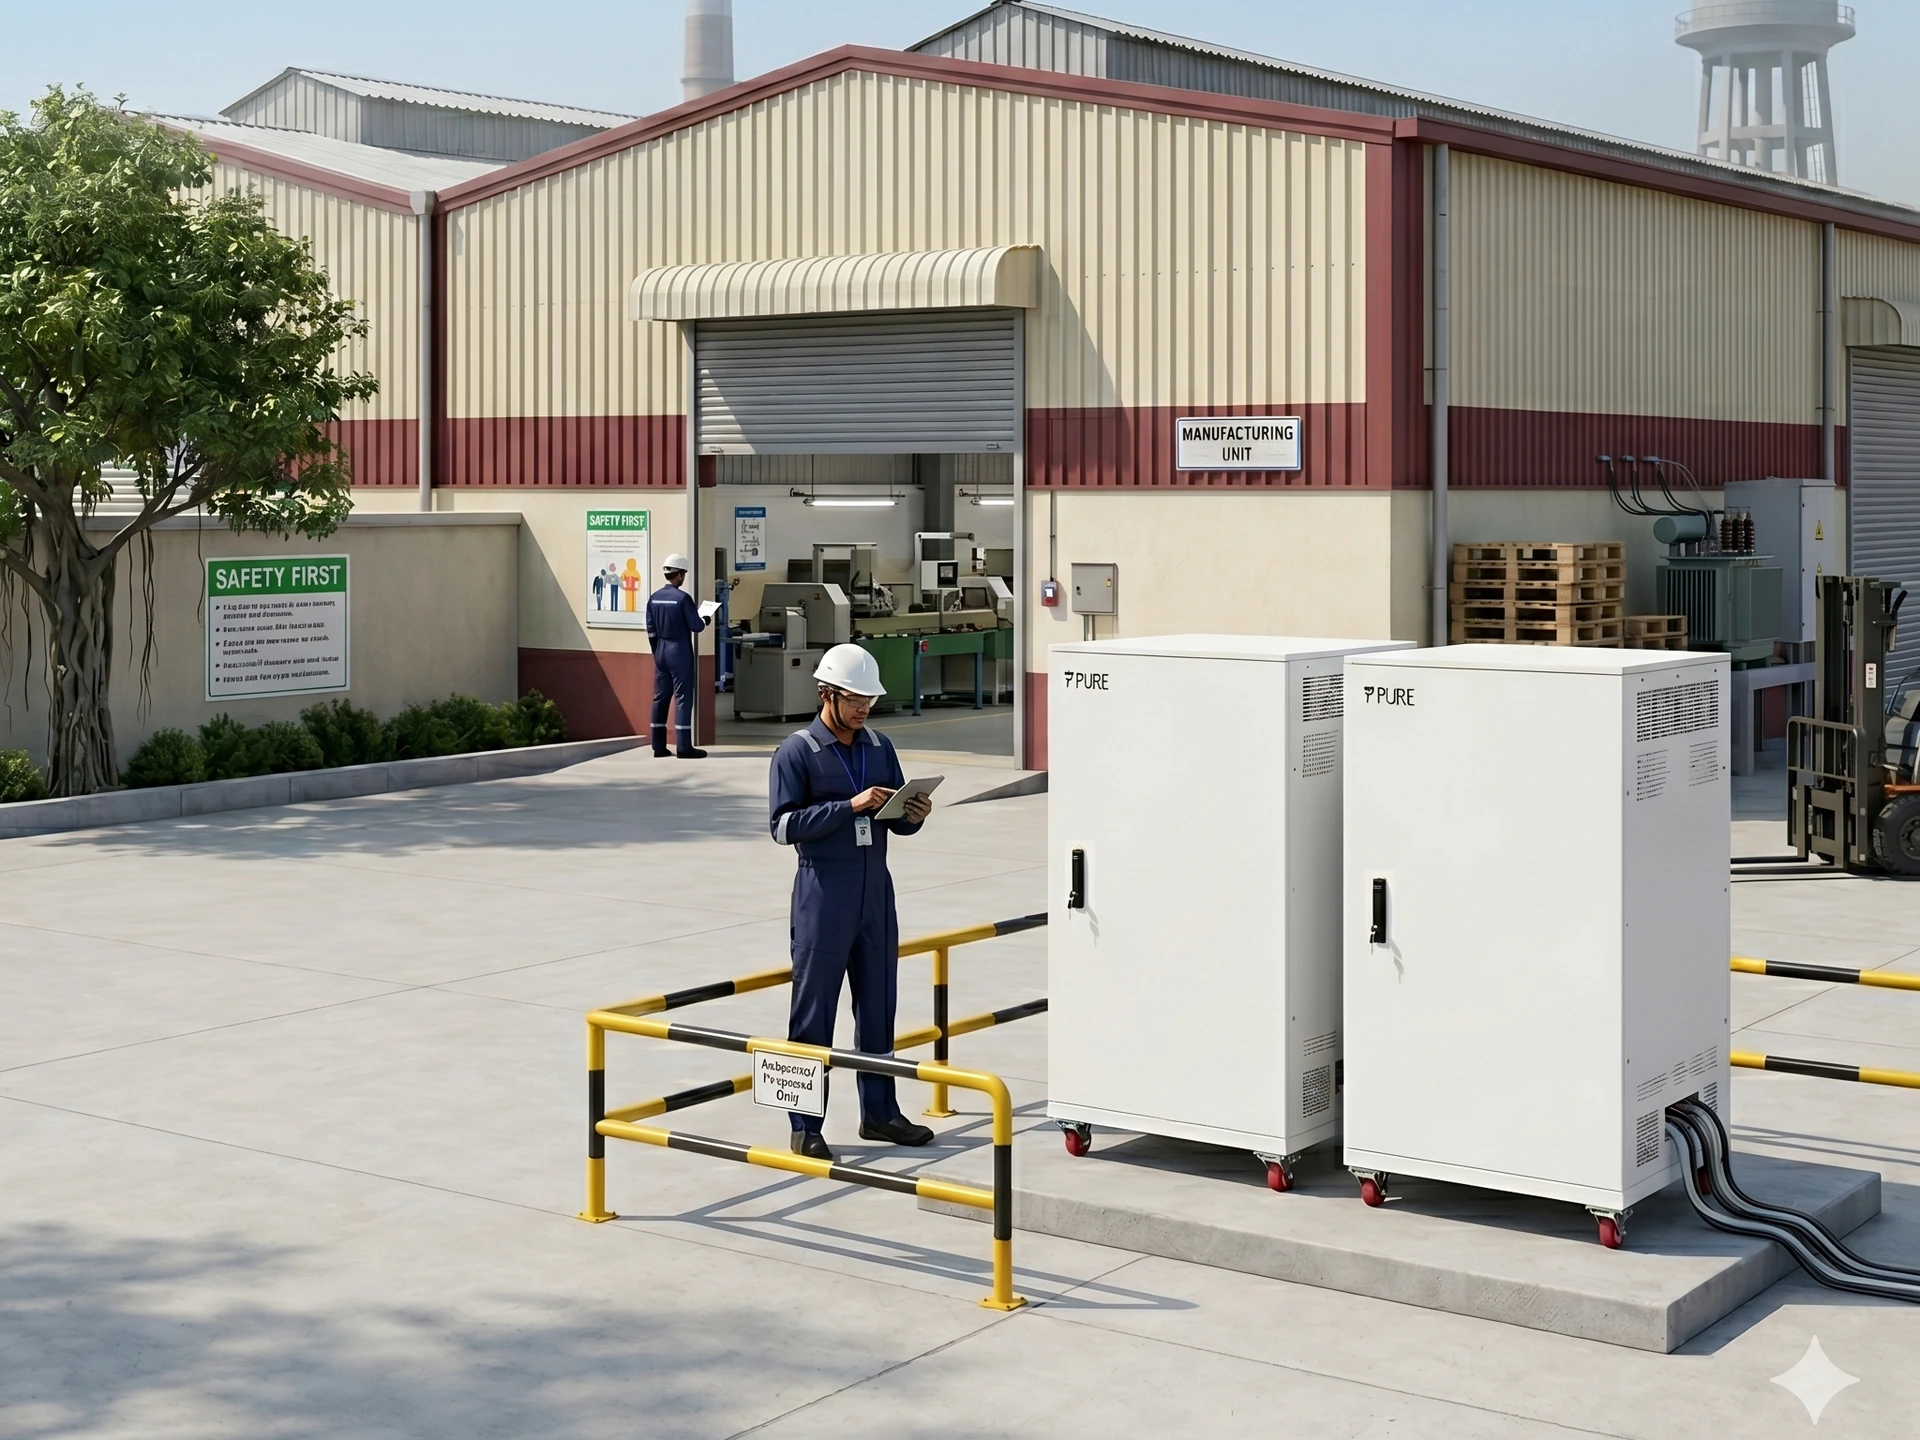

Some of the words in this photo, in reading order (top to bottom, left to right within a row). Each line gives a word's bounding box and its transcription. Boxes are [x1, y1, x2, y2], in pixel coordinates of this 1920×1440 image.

[1182, 425, 1294, 441] MANUFACTURING
[1222, 446, 1252, 462] UNIT
[589, 514, 620, 527] SAFETY
[621, 514, 645, 527] FIRST
[215, 566, 285, 590] SAFETY
[291, 564, 341, 587] FIRST
[1076, 672, 1109, 690] PURE
[1377, 686, 1415, 706] PURE
